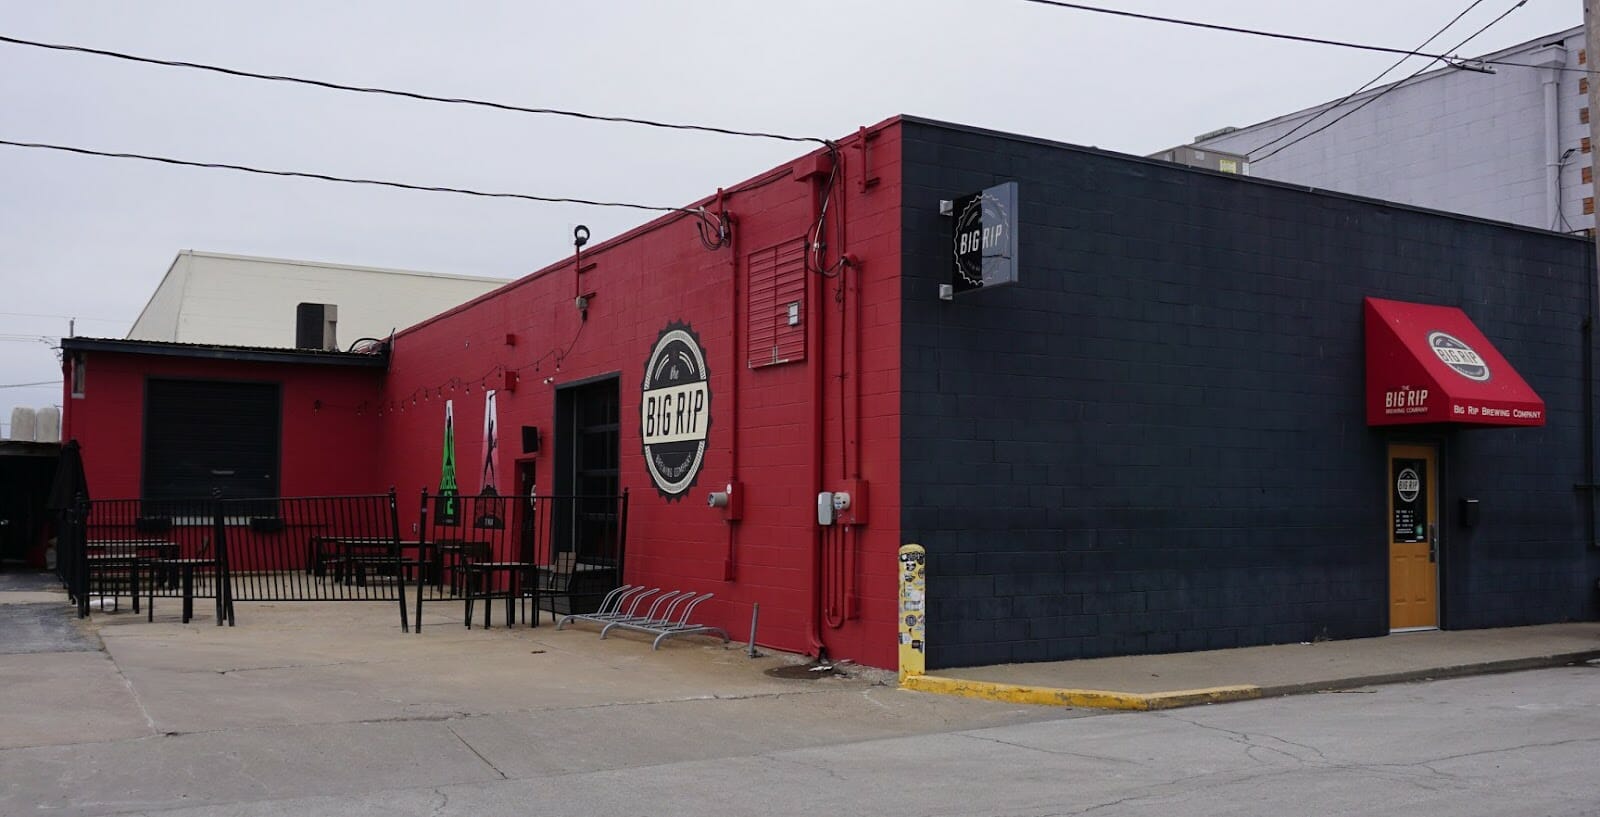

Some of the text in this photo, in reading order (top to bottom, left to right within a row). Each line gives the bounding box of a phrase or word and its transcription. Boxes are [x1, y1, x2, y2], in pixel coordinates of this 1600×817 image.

[960, 224, 1002, 255] BIG RIP
[1436, 348, 1478, 364] BIG RIP
[1385, 390, 1428, 407] BIG RIP
[646, 389, 704, 437] BIG RIP
[1399, 480, 1417, 490] BIG RIP
